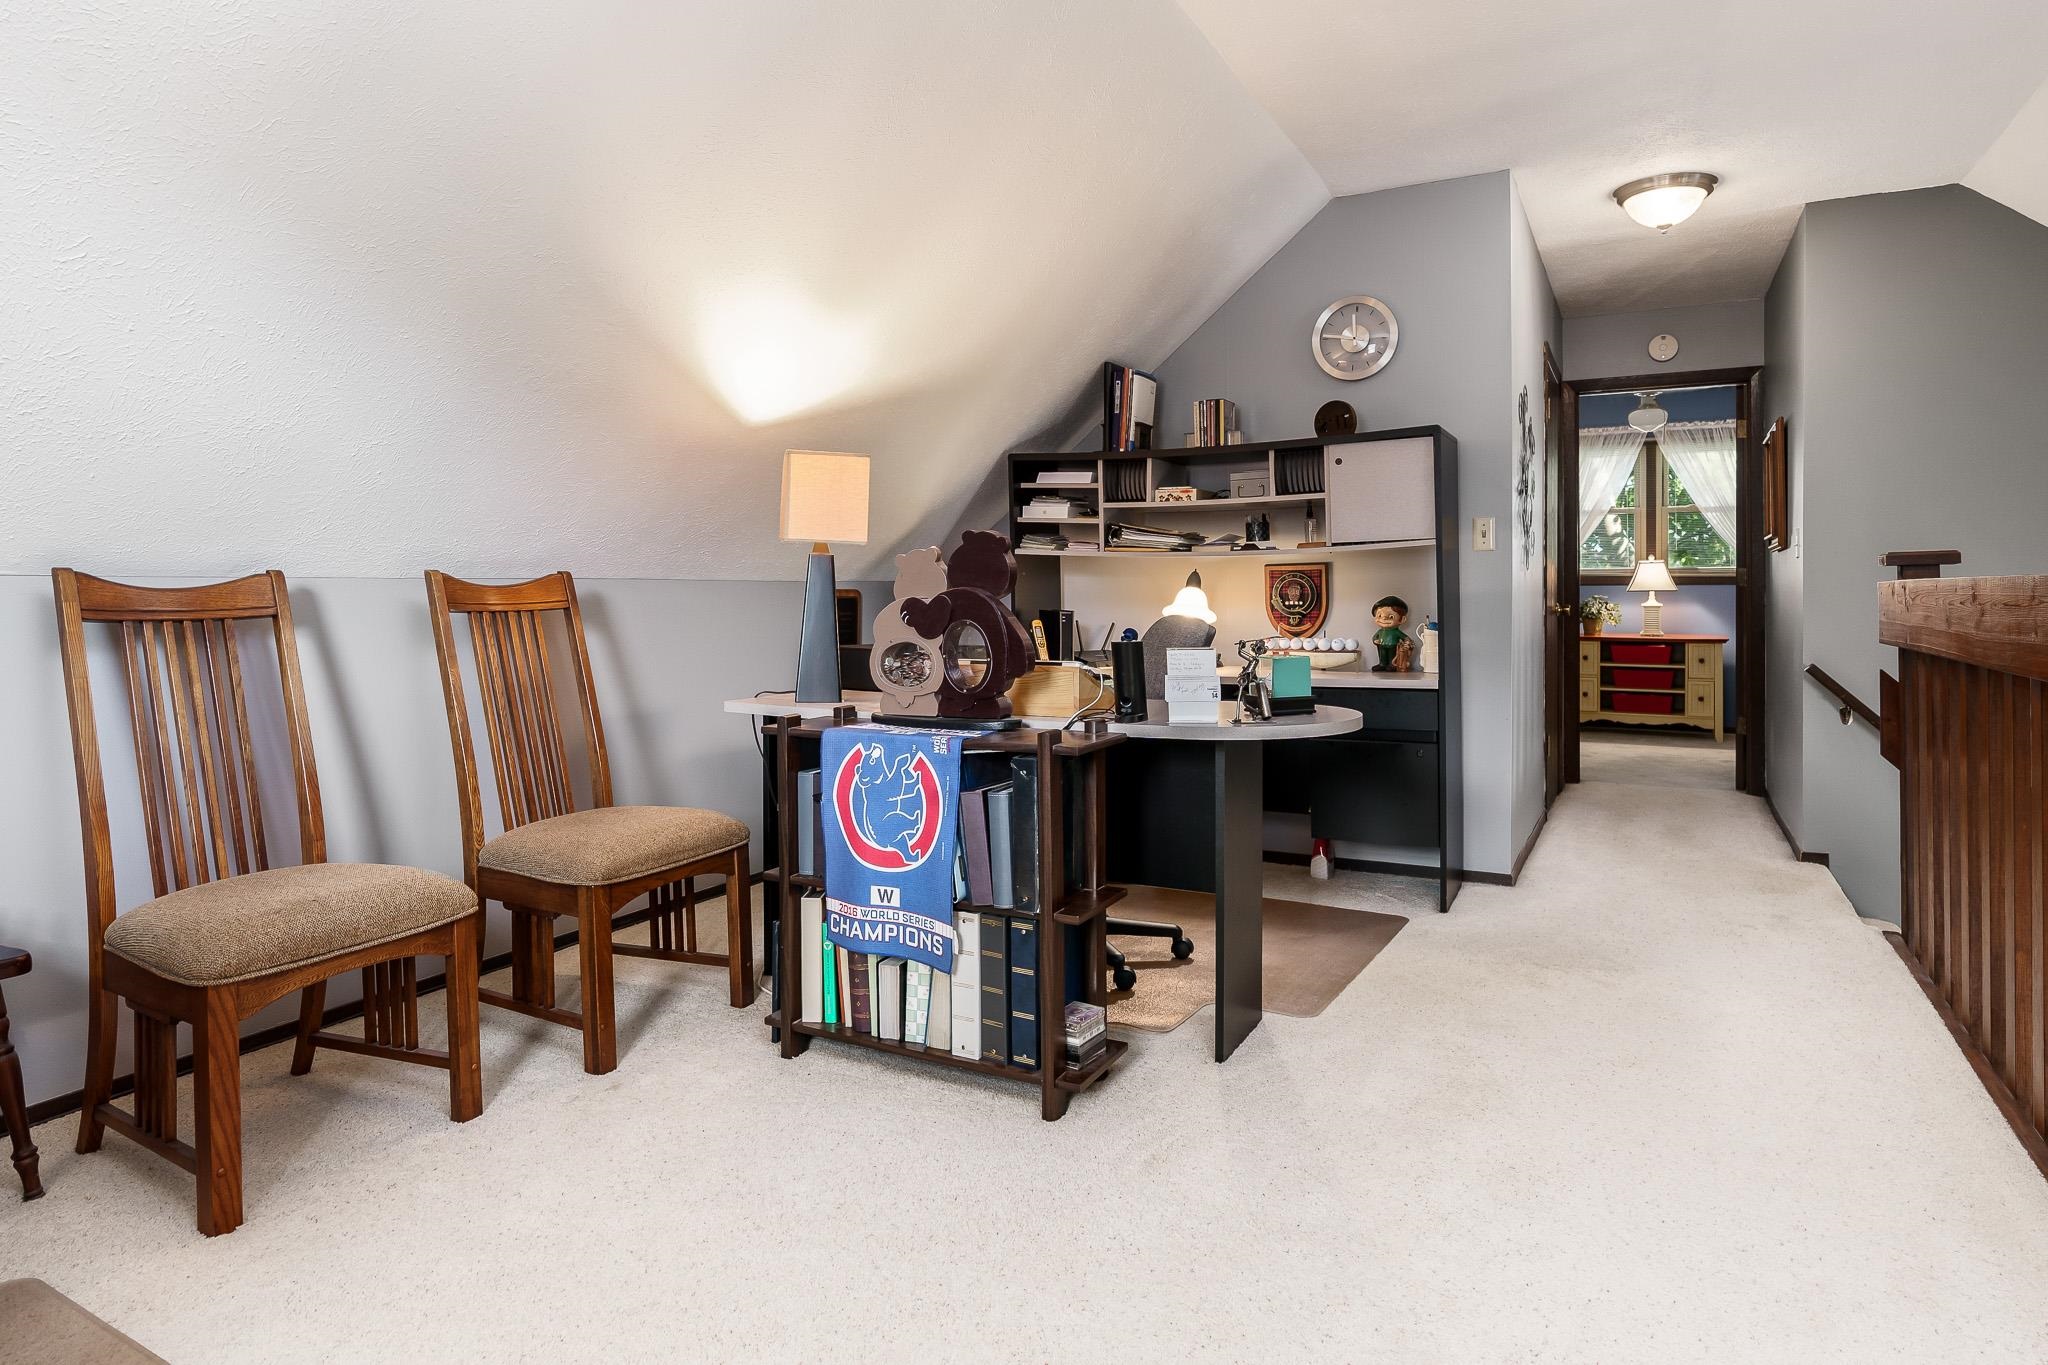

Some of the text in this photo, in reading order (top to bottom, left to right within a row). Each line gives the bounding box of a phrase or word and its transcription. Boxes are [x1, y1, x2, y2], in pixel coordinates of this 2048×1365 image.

[877, 888, 894, 904] W
[839, 903, 935, 930] 2016 WORLD SERIES
[830, 913, 944, 957] CHAMPIONS
